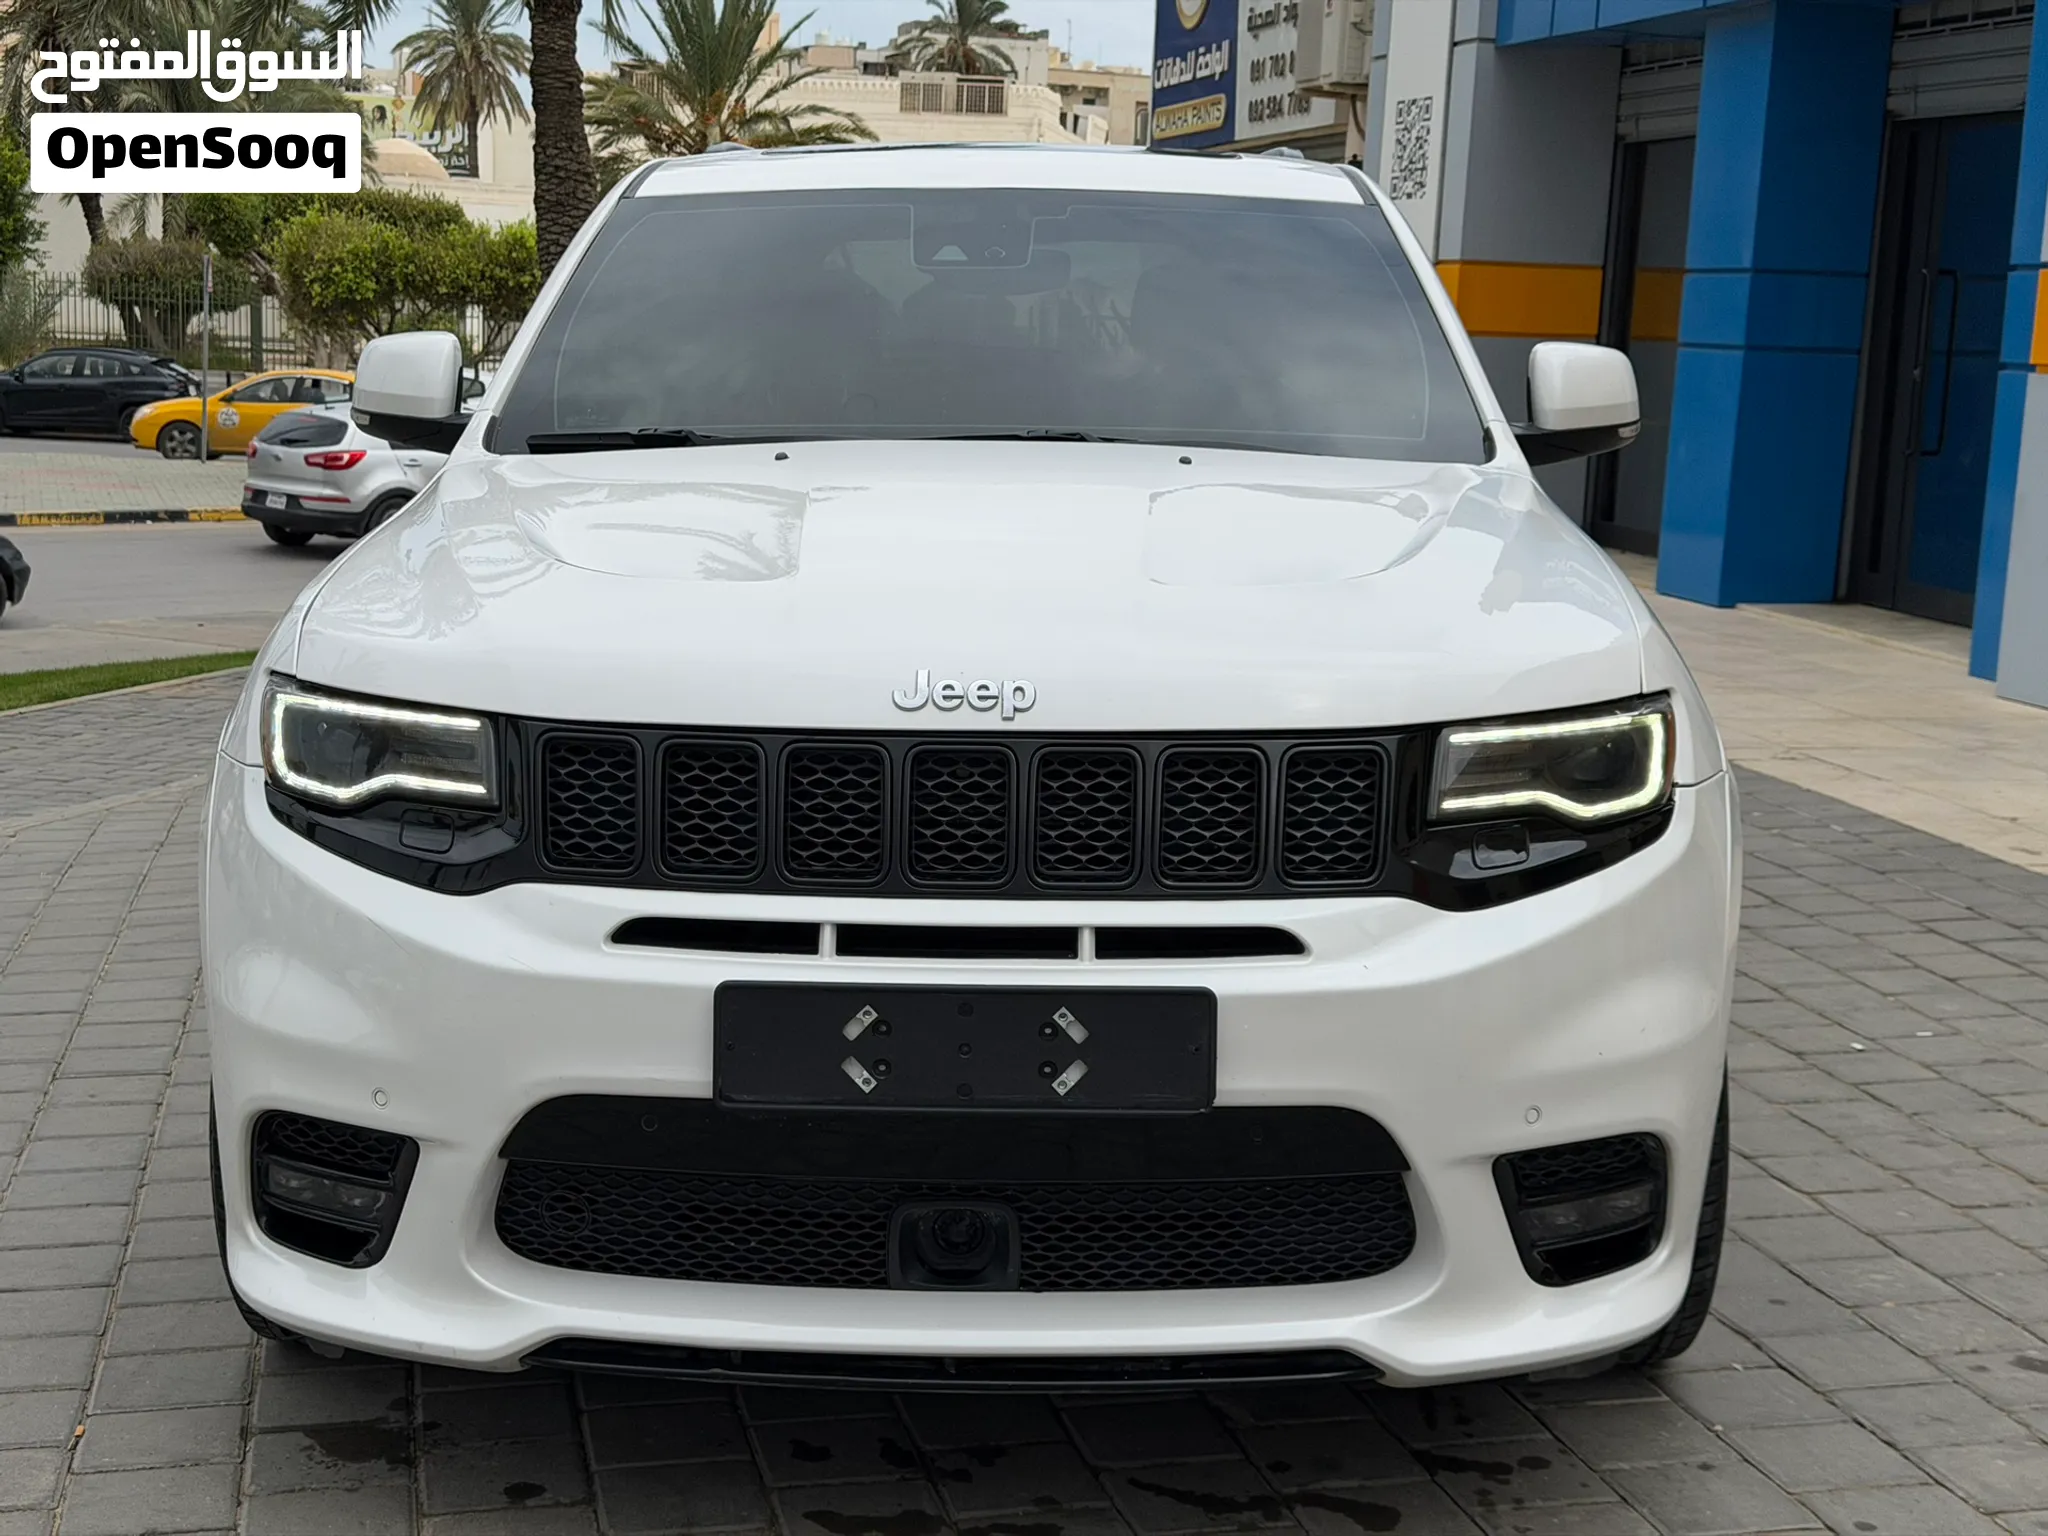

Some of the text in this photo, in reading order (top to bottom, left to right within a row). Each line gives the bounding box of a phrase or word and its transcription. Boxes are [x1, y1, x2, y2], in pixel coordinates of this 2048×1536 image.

[1154, 39, 1230, 89] الواحة للدهانات
[1191, 101, 1222, 125] PAINTS
[892, 669, 1036, 721] Jeep
